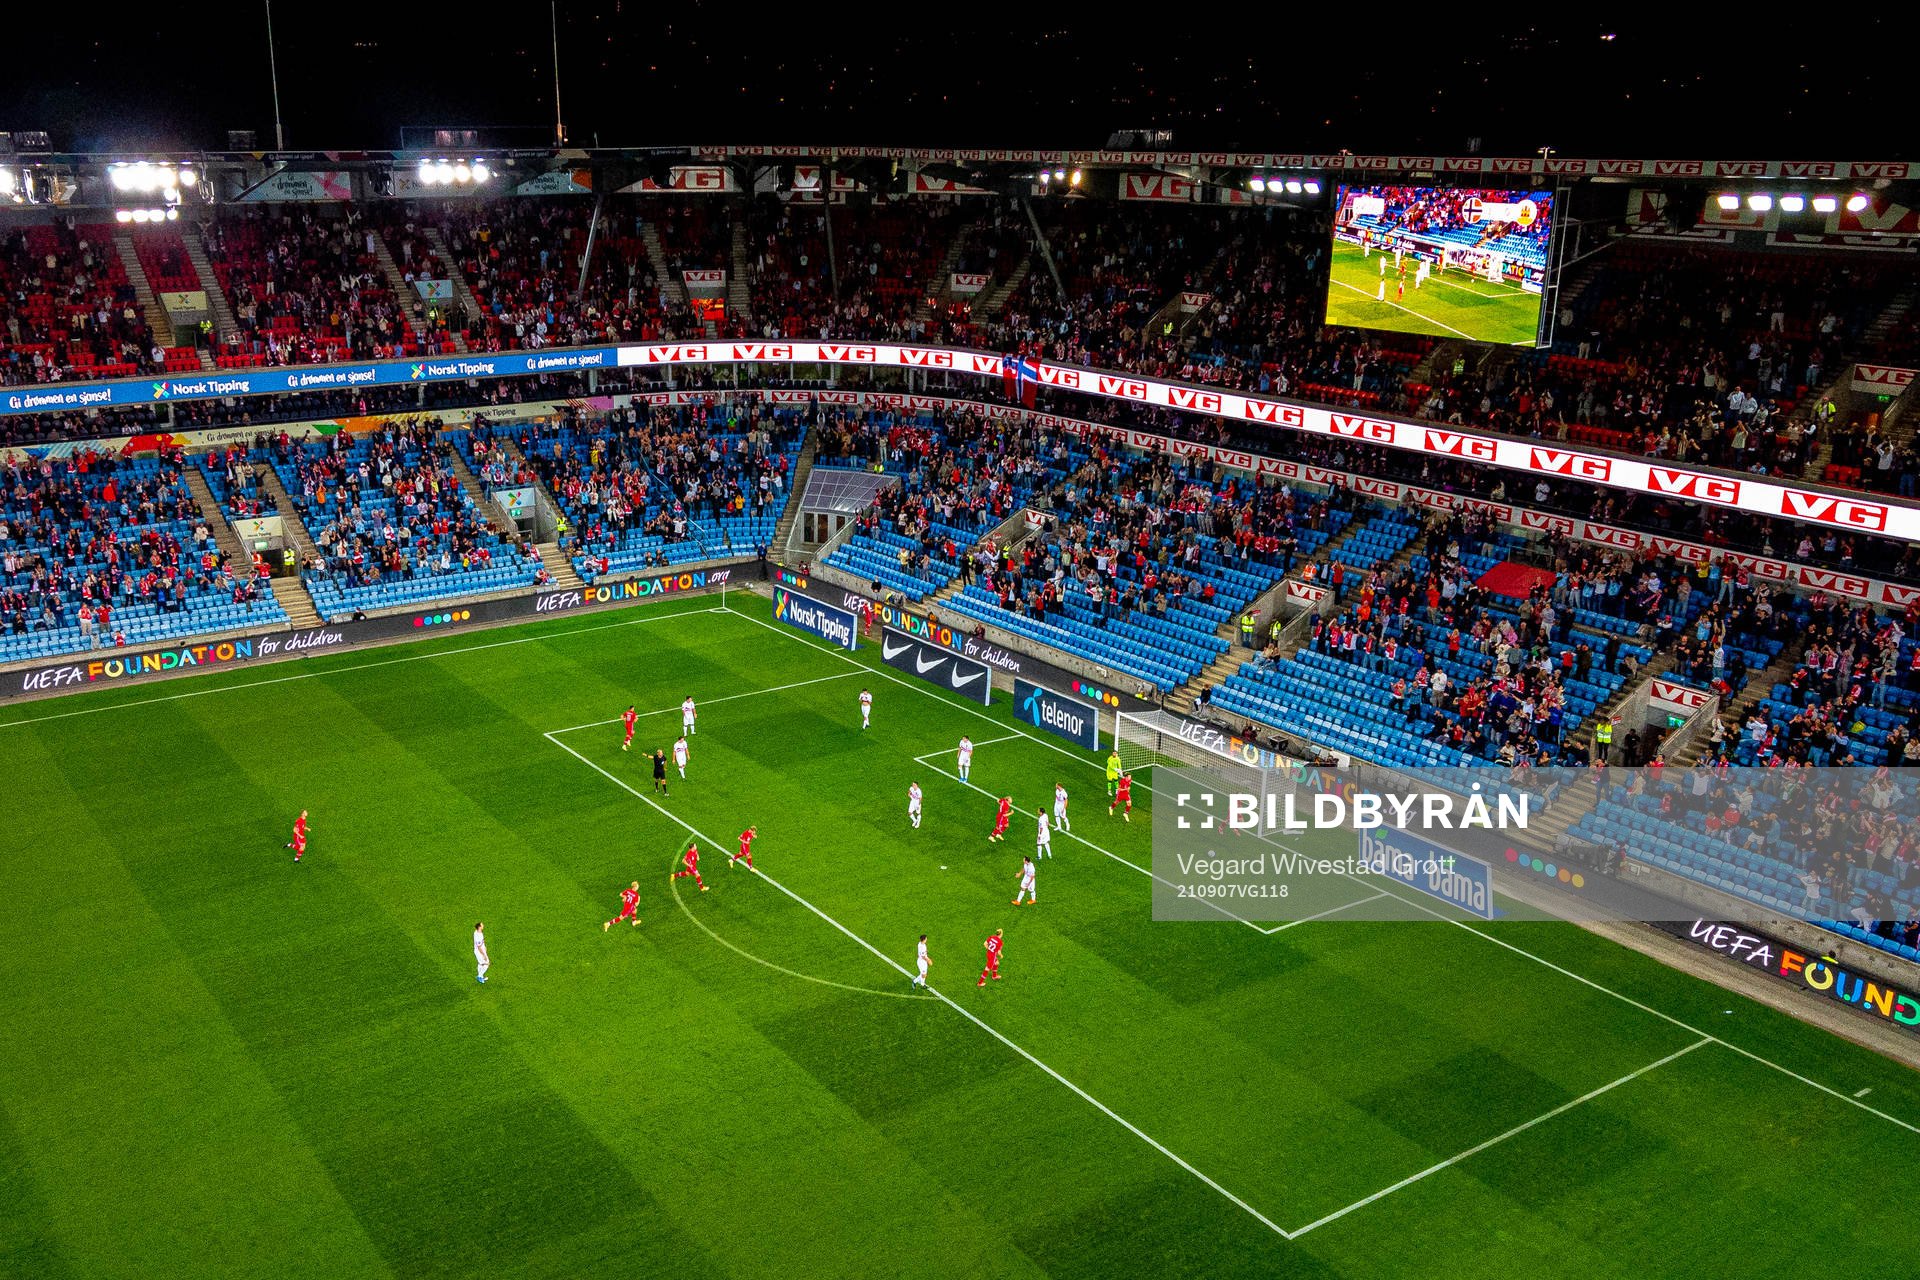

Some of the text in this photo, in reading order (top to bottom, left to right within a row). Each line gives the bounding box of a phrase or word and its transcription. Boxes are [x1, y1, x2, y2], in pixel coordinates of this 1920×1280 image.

[701, 147, 727, 155] VG
[736, 147, 762, 155] VG
[773, 147, 799, 155] VG
[810, 148, 832, 156] VG
[838, 148, 859, 156] VG
[961, 150, 979, 159] VG
[986, 151, 1005, 159] VG
[1012, 151, 1032, 160] VG
[1041, 152, 1061, 161] VG
[1070, 152, 1091, 161] VG
[1100, 152, 1123, 161] VG
[1131, 153, 1154, 162] VG
[1165, 153, 1189, 163] VG
[1201, 154, 1225, 164] VG
[1237, 155, 1263, 165] VG
[1274, 155, 1302, 166] VG
[1313, 156, 1343, 167] VG
[1356, 157, 1387, 168] VG
[1401, 158, 1433, 169] VG
[1444, 159, 1480, 170] VG
[1494, 160, 1530, 171] VG
[1546, 161, 1585, 172] VG
[1602, 161, 1640, 173] VG
[1656, 163, 1701, 174] VG
[1719, 164, 1765, 175] VG
[1783, 164, 1833, 176] VG
[1854, 165, 1906, 177] VG
[1129, 175, 1192, 198] VG
[288, 375, 299, 387] Gi
[336, 374, 347, 383] en
[347, 368, 376, 384] sjanse!
[429, 362, 495, 376] Norsk Tipping
[527, 358, 537, 370] Gi
[1859, 366, 1915, 385] VG
[9, 396, 22, 409] Gi
[66, 394, 78, 404] en
[79, 388, 112, 404] sjanse!
[173, 380, 250, 395] Norsk Tipping
[650, 346, 705, 361] VG
[735, 345, 790, 359] VG
[820, 346, 875, 361] VG
[901, 350, 952, 367] VG
[1040, 367, 1079, 388] VG
[1100, 375, 1146, 399] VG
[1170, 388, 1220, 412] VG
[1247, 401, 1303, 427] VG
[1331, 414, 1394, 443] VG
[1426, 431, 1496, 461] VG
[1532, 449, 1610, 481] VG
[1651, 469, 1738, 503] VG
[1784, 491, 1886, 530] VG
[772, 392, 811, 402] VG
[820, 392, 857, 403] VG
[911, 398, 942, 410] VG
[1216, 450, 1251, 468] VG
[1261, 459, 1297, 478] VG
[1307, 468, 1347, 486] VG
[1356, 478, 1398, 498] VG
[1409, 489, 1451, 509] VG
[1522, 512, 1573, 534] VG
[1585, 525, 1640, 548] VG
[1652, 538, 1710, 562] VG
[1803, 569, 1869, 596] VG
[536, 591, 581, 612] UEFA
[584, 572, 705, 605] FOUNDATION
[790, 600, 850, 647] Norsk Tipping
[873, 602, 963, 651] FOUNDATION
[964, 637, 980, 658] for
[981, 644, 1020, 673] children
[23, 629, 343, 691] UEFA FOUNDATION for children
[1655, 682, 1710, 708] VG
[1041, 694, 1085, 737] telenor
[1179, 718, 1226, 751] UEFA
[1429, 850, 1485, 911] bama
[1690, 917, 1920, 1026] UEFA FOUND
